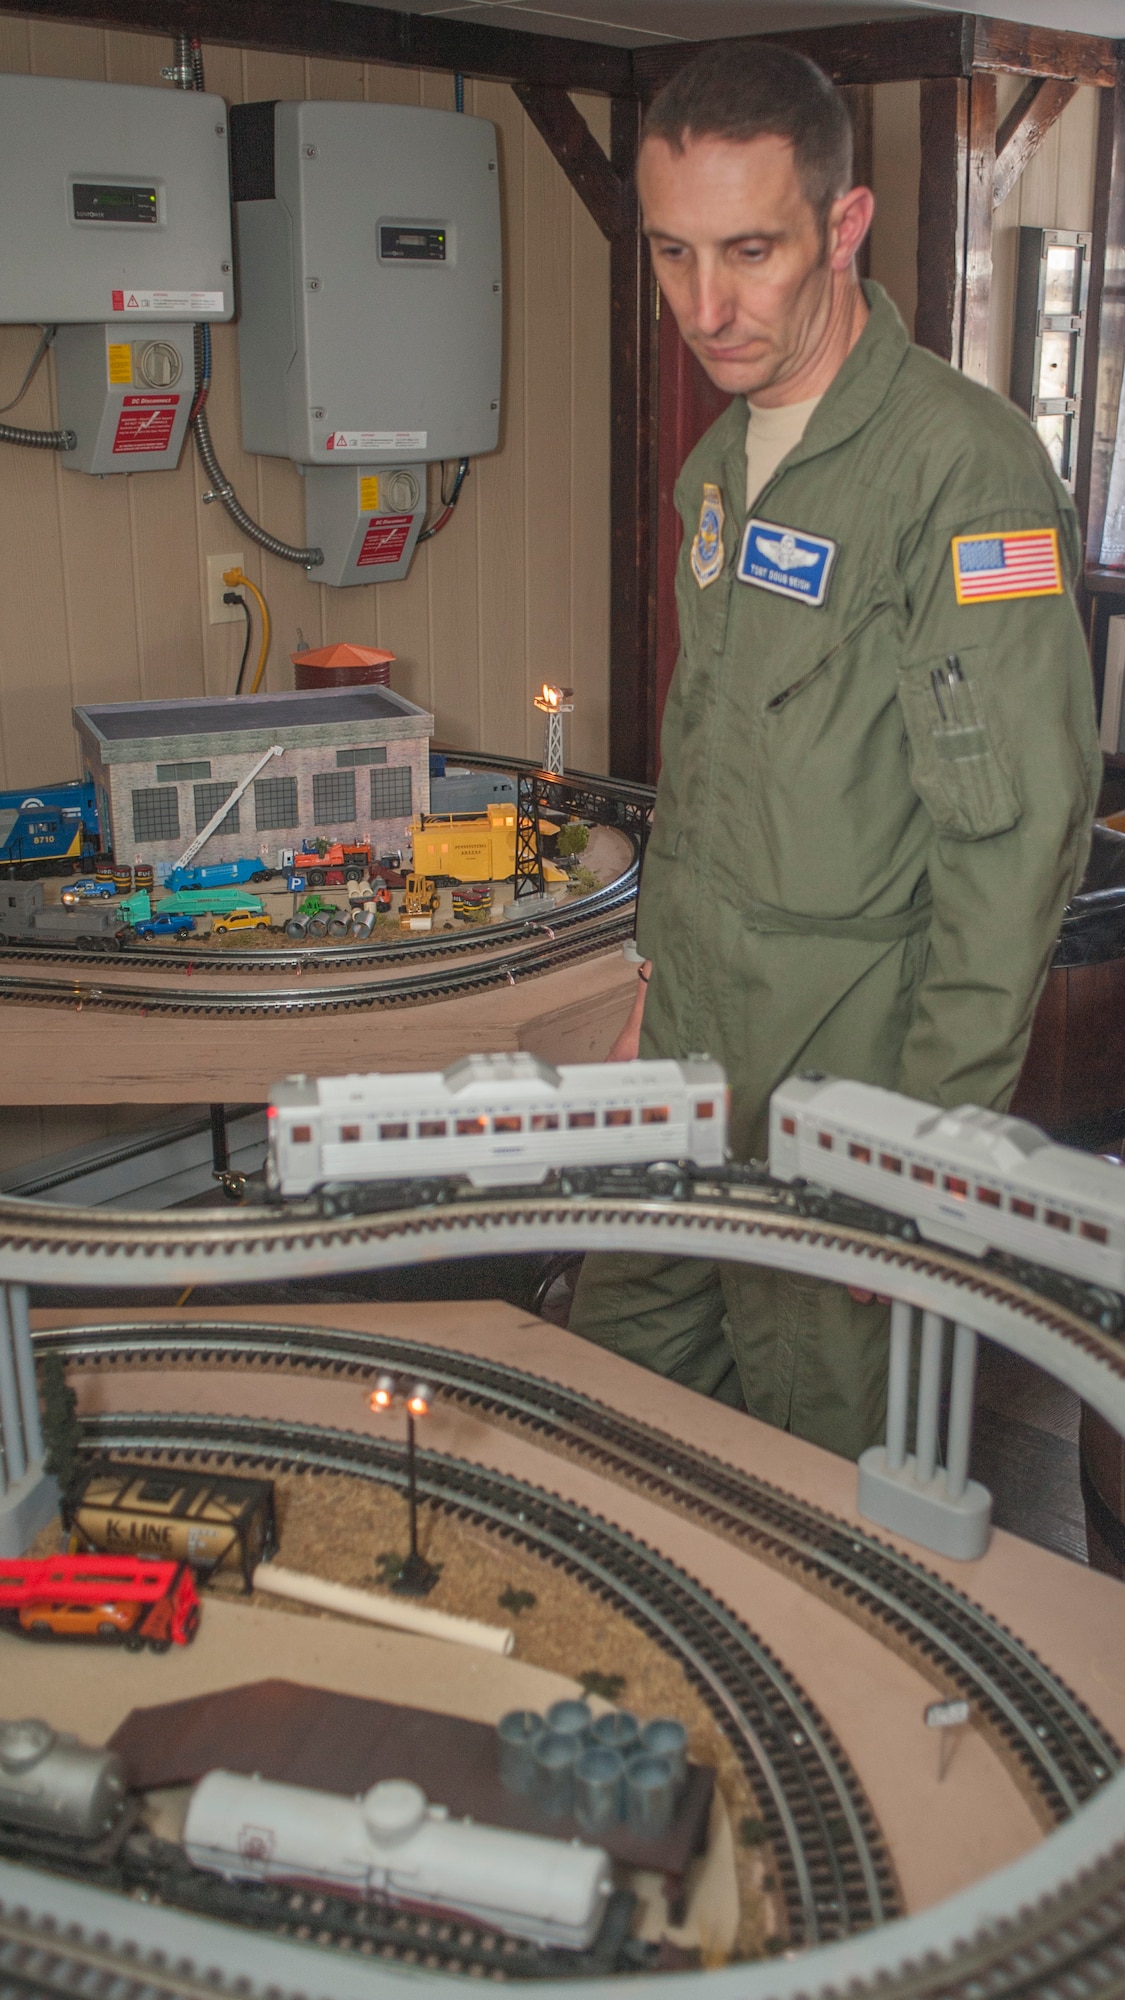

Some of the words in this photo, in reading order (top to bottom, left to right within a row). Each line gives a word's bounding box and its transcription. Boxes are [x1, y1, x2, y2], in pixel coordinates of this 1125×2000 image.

[33, 835, 55, 844] 8710
[292, 877, 302, 890] P
[106, 1519, 174, 1543] K-LINE
